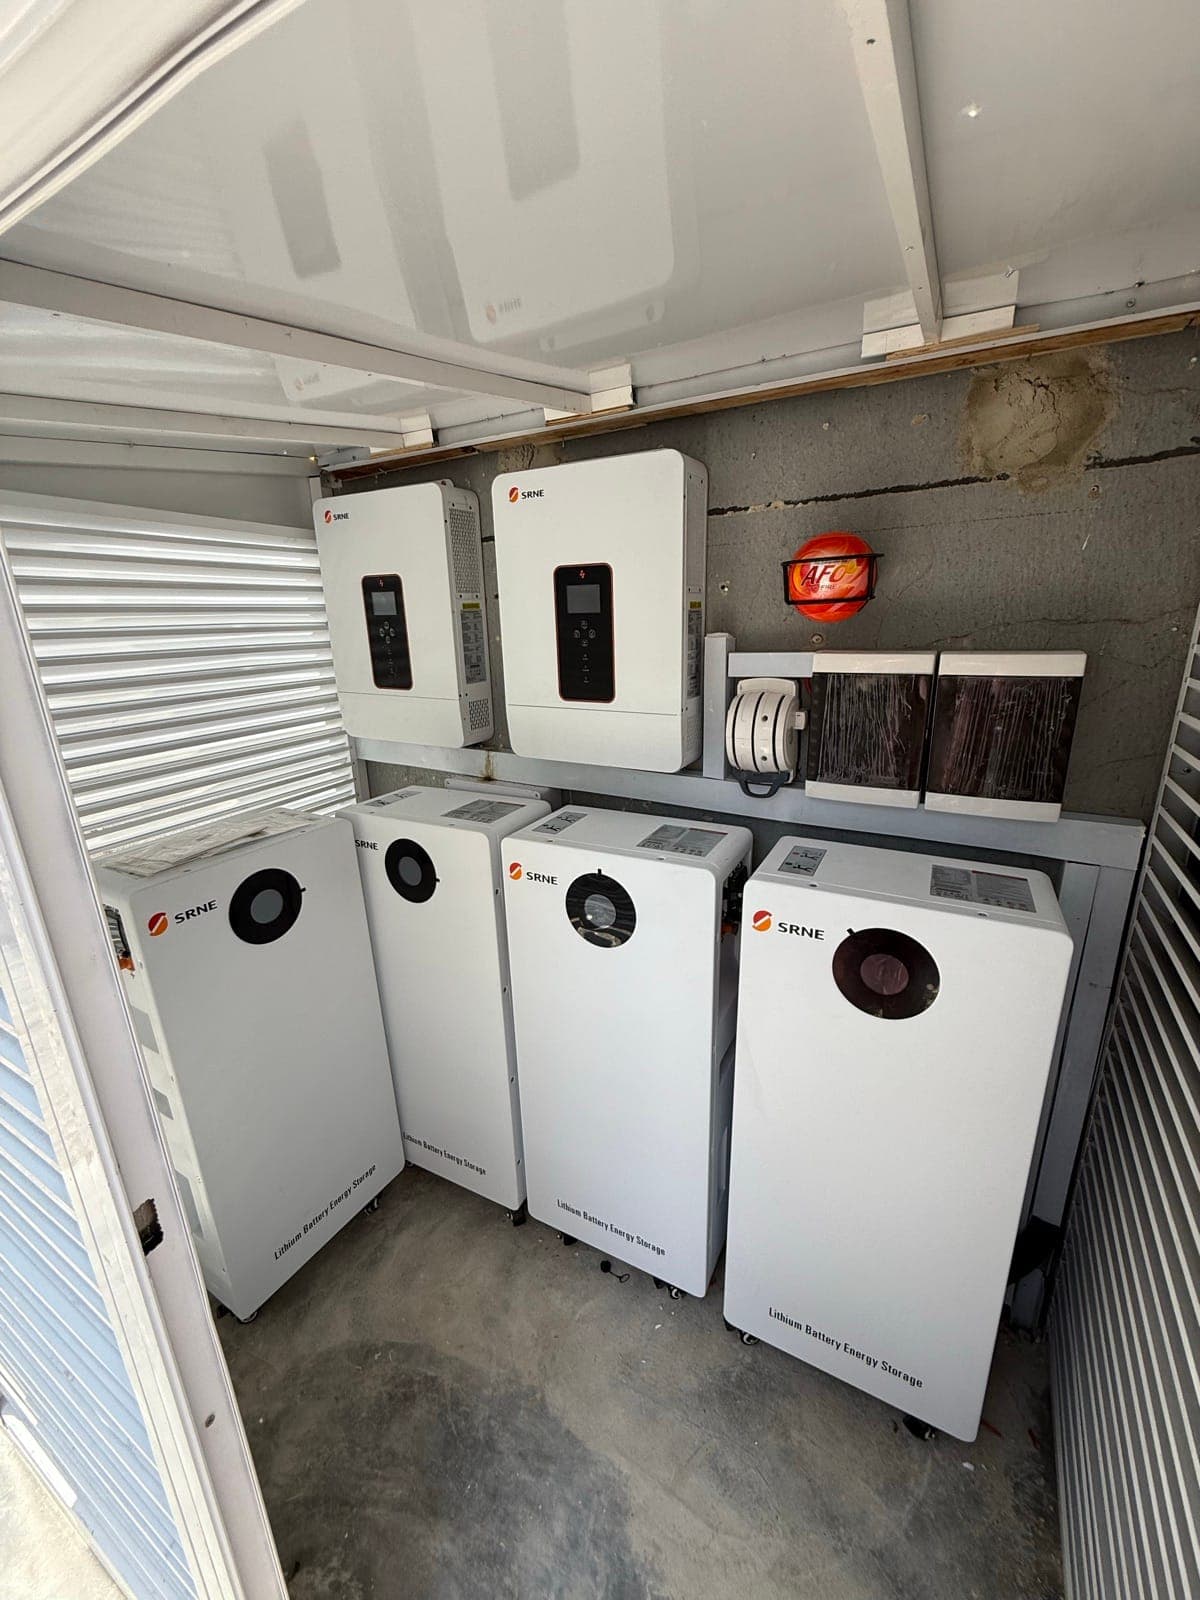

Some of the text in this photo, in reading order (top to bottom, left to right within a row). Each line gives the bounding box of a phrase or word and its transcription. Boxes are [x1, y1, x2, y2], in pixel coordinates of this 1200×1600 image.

[521, 489, 545, 500] SRNE
[333, 512, 350, 521] SRNE
[355, 839, 379, 851] SRNE
[526, 871, 558, 885] SRNE
[174, 899, 218, 924] SRNE
[777, 921, 825, 941] SRNE
[402, 1131, 486, 1175] Lithium Battery Energy Storage
[273, 1164, 377, 1260] Lithium Battery Energy Storage
[557, 1199, 666, 1256] Lithium Battery Energy Storage
[768, 1306, 923, 1388] Lithium Battery Energy Storage
